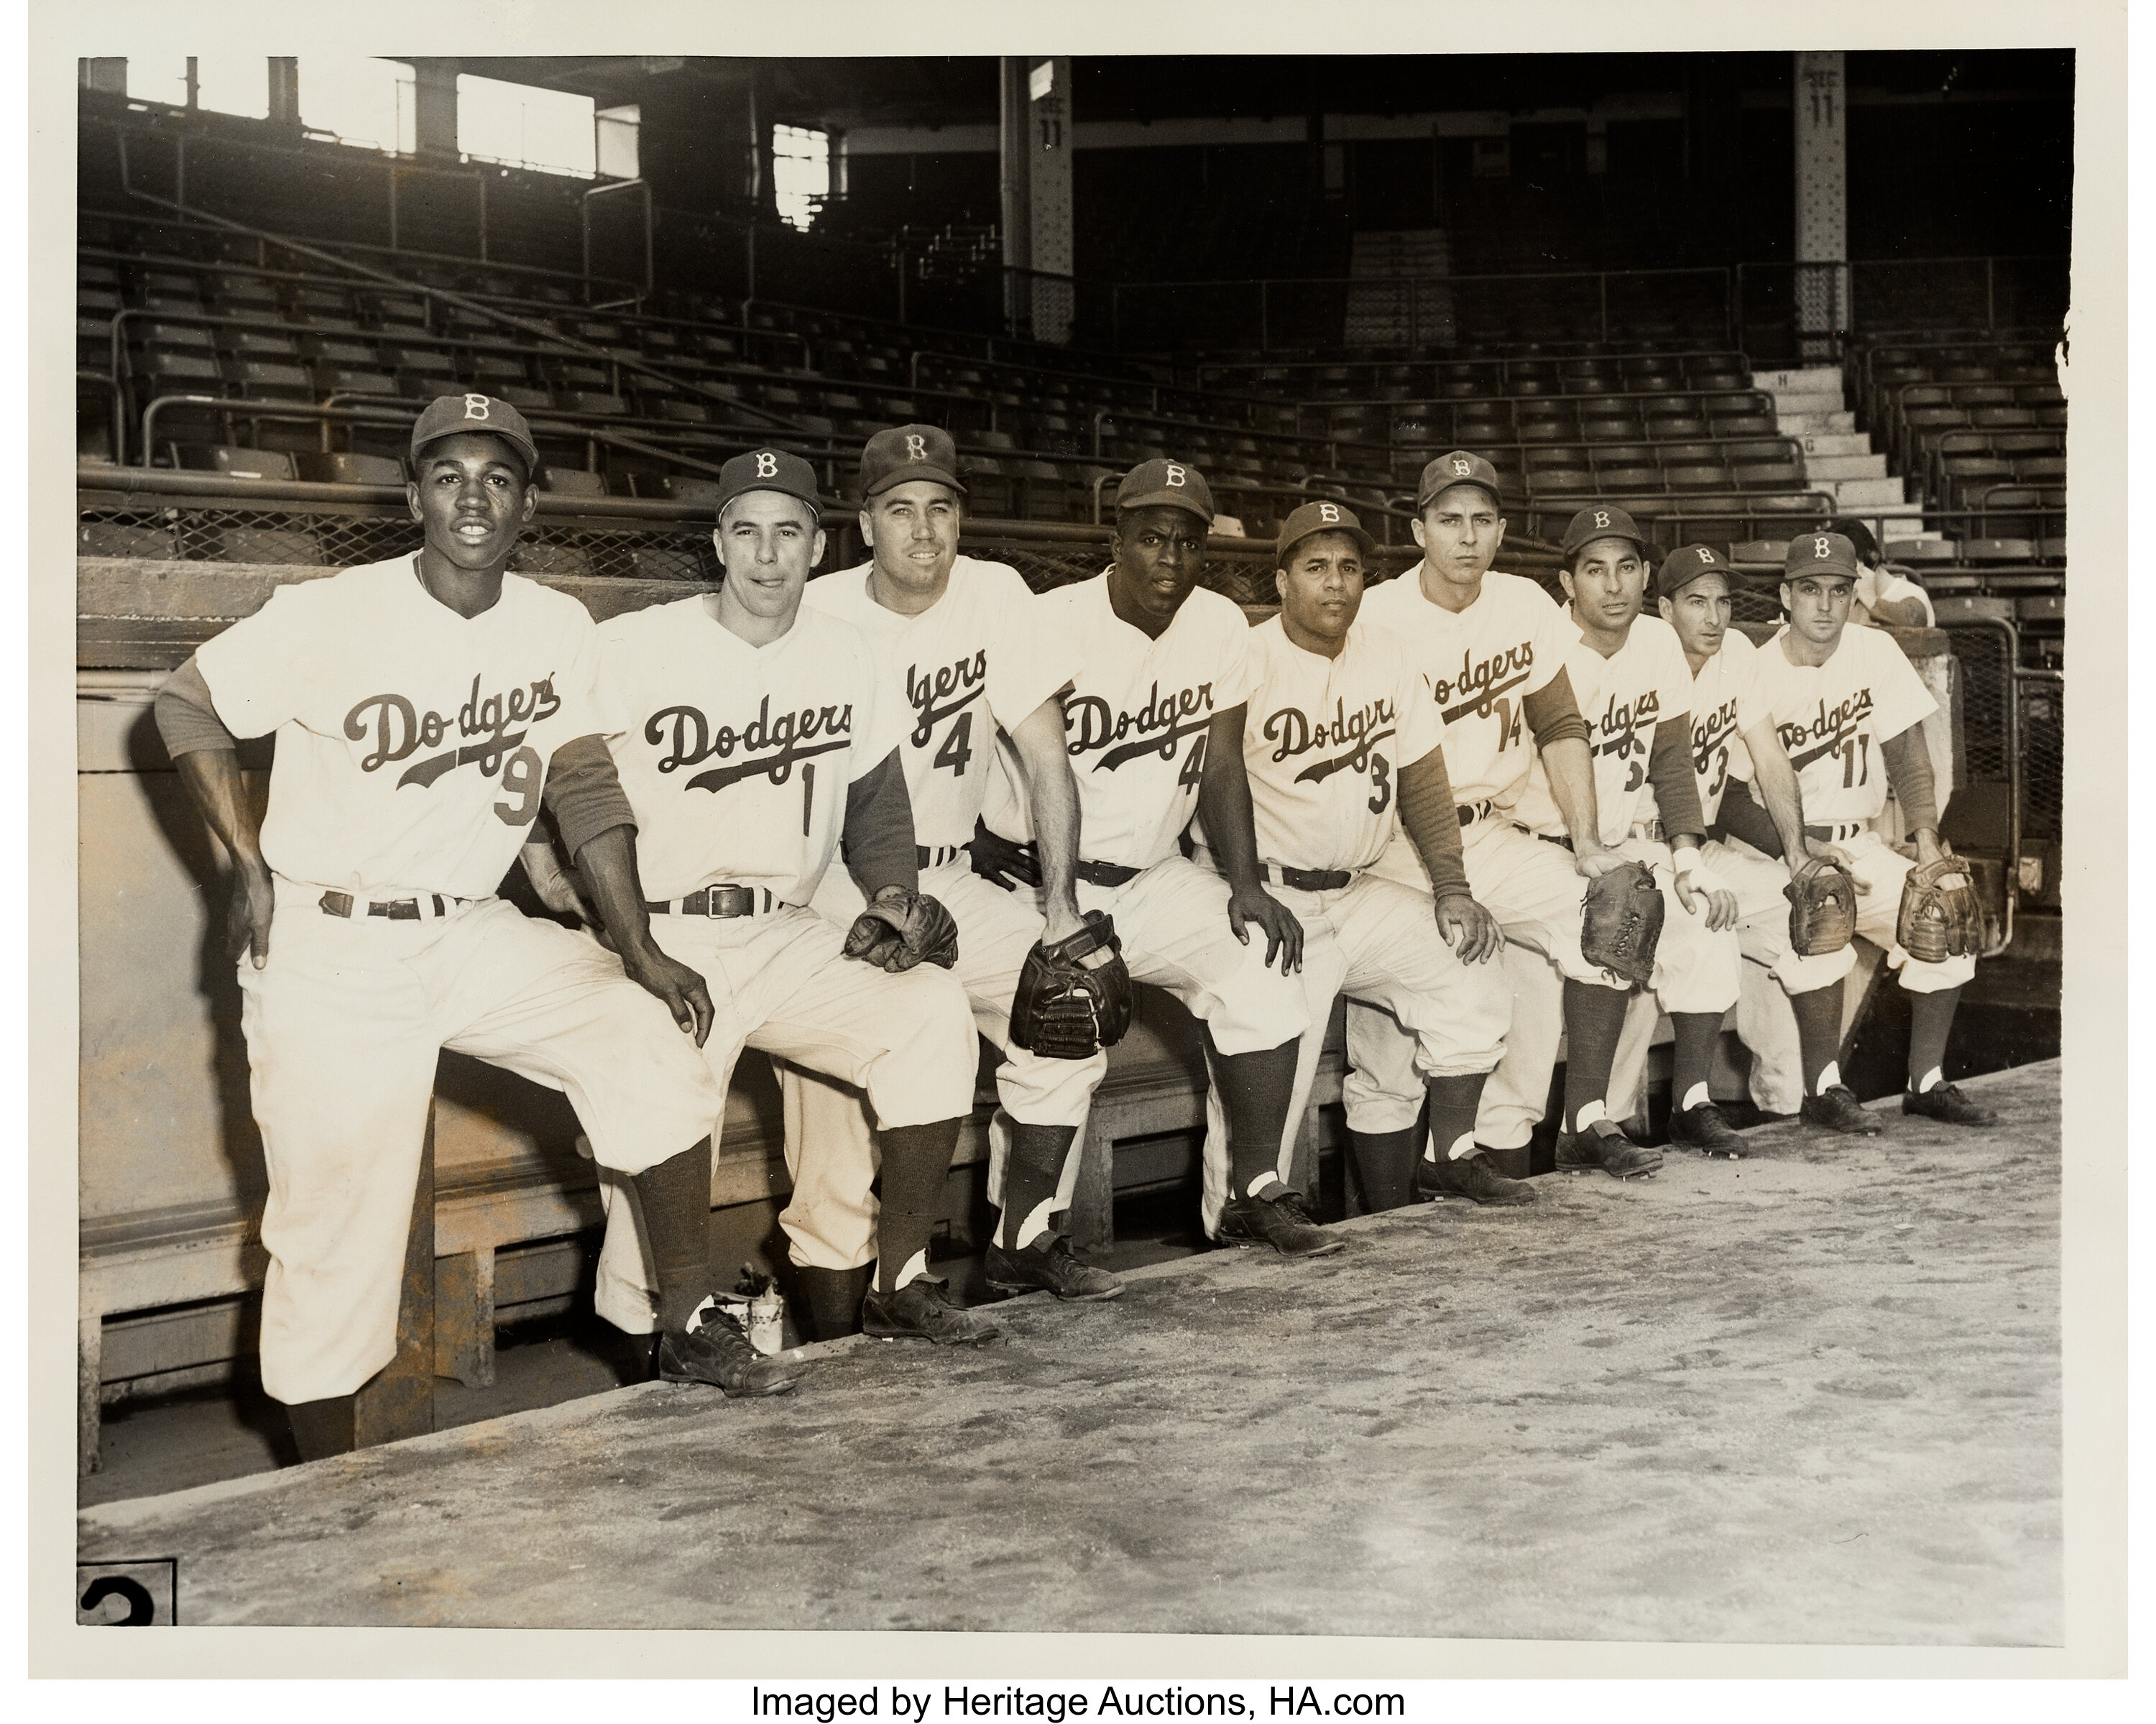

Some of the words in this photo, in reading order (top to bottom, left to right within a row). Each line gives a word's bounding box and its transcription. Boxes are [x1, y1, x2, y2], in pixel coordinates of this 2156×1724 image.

[1810, 94, 1833, 129] 11
[1040, 119, 1061, 149] 11
[464, 393, 489, 420] B
[755, 453, 778, 478] B
[1166, 464, 1186, 487] B
[1452, 459, 1471, 476] B
[1319, 503, 1340, 522] B
[1593, 511, 1611, 529] B
[1695, 548, 1715, 563] B
[1814, 537, 1831, 558] B
[1422, 641, 1534, 719] odgers
[344, 671, 561, 778] Dodgers
[933, 711, 973, 777] 4
[1493, 697, 1521, 752] 14
[1691, 696, 1737, 775] gers
[494, 746, 543, 826] 9
[1178, 734, 1207, 796] 4
[1368, 753, 1391, 815] 3
[1709, 746, 1729, 797] 3
[802, 762, 815, 836] 1
